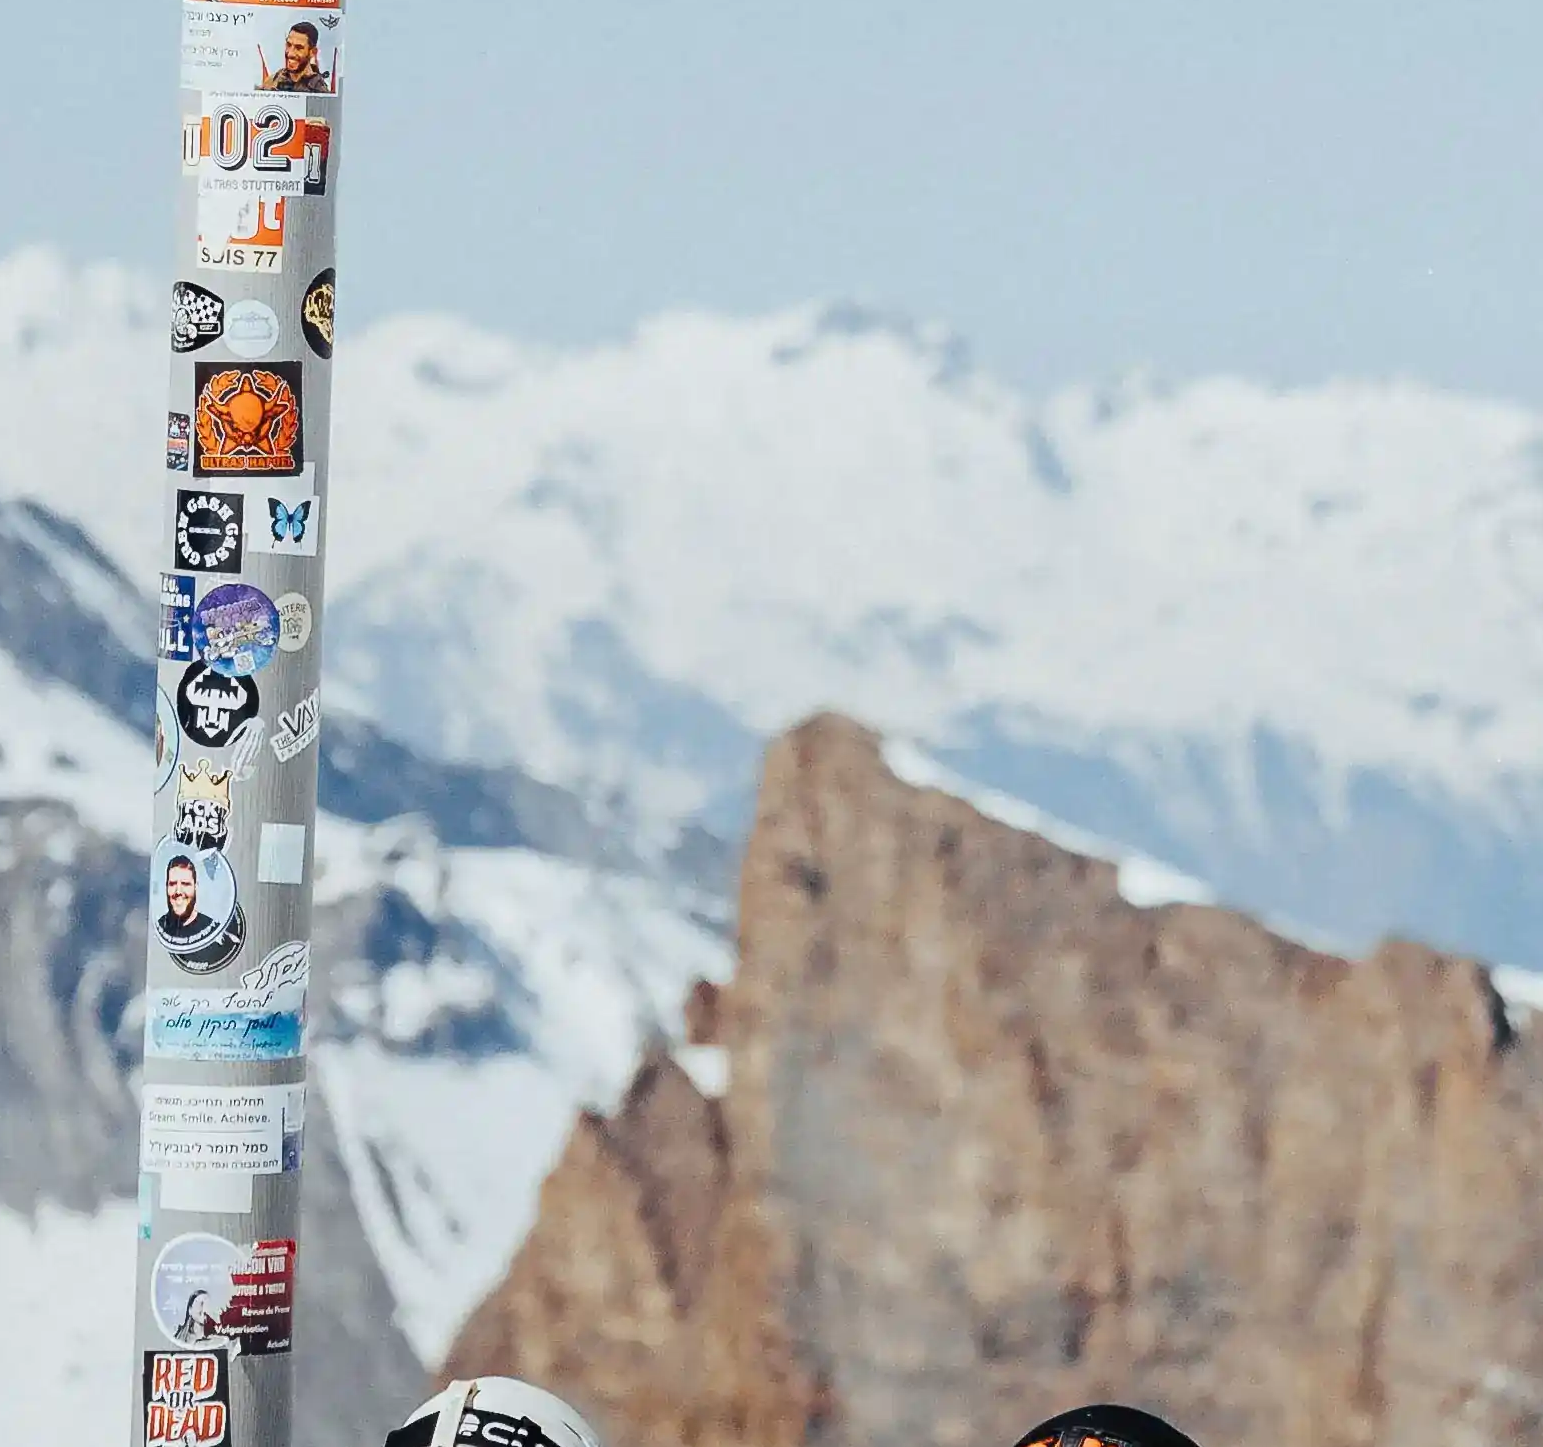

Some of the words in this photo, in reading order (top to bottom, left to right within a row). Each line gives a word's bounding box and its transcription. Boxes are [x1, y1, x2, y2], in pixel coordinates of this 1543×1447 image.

[241, 180, 301, 192] STUTTGART
[253, 250, 278, 268] 77
[202, 456, 245, 468] ULTRAS
[155, 1357, 216, 1395] RED
[149, 1404, 224, 1443] DEAD
